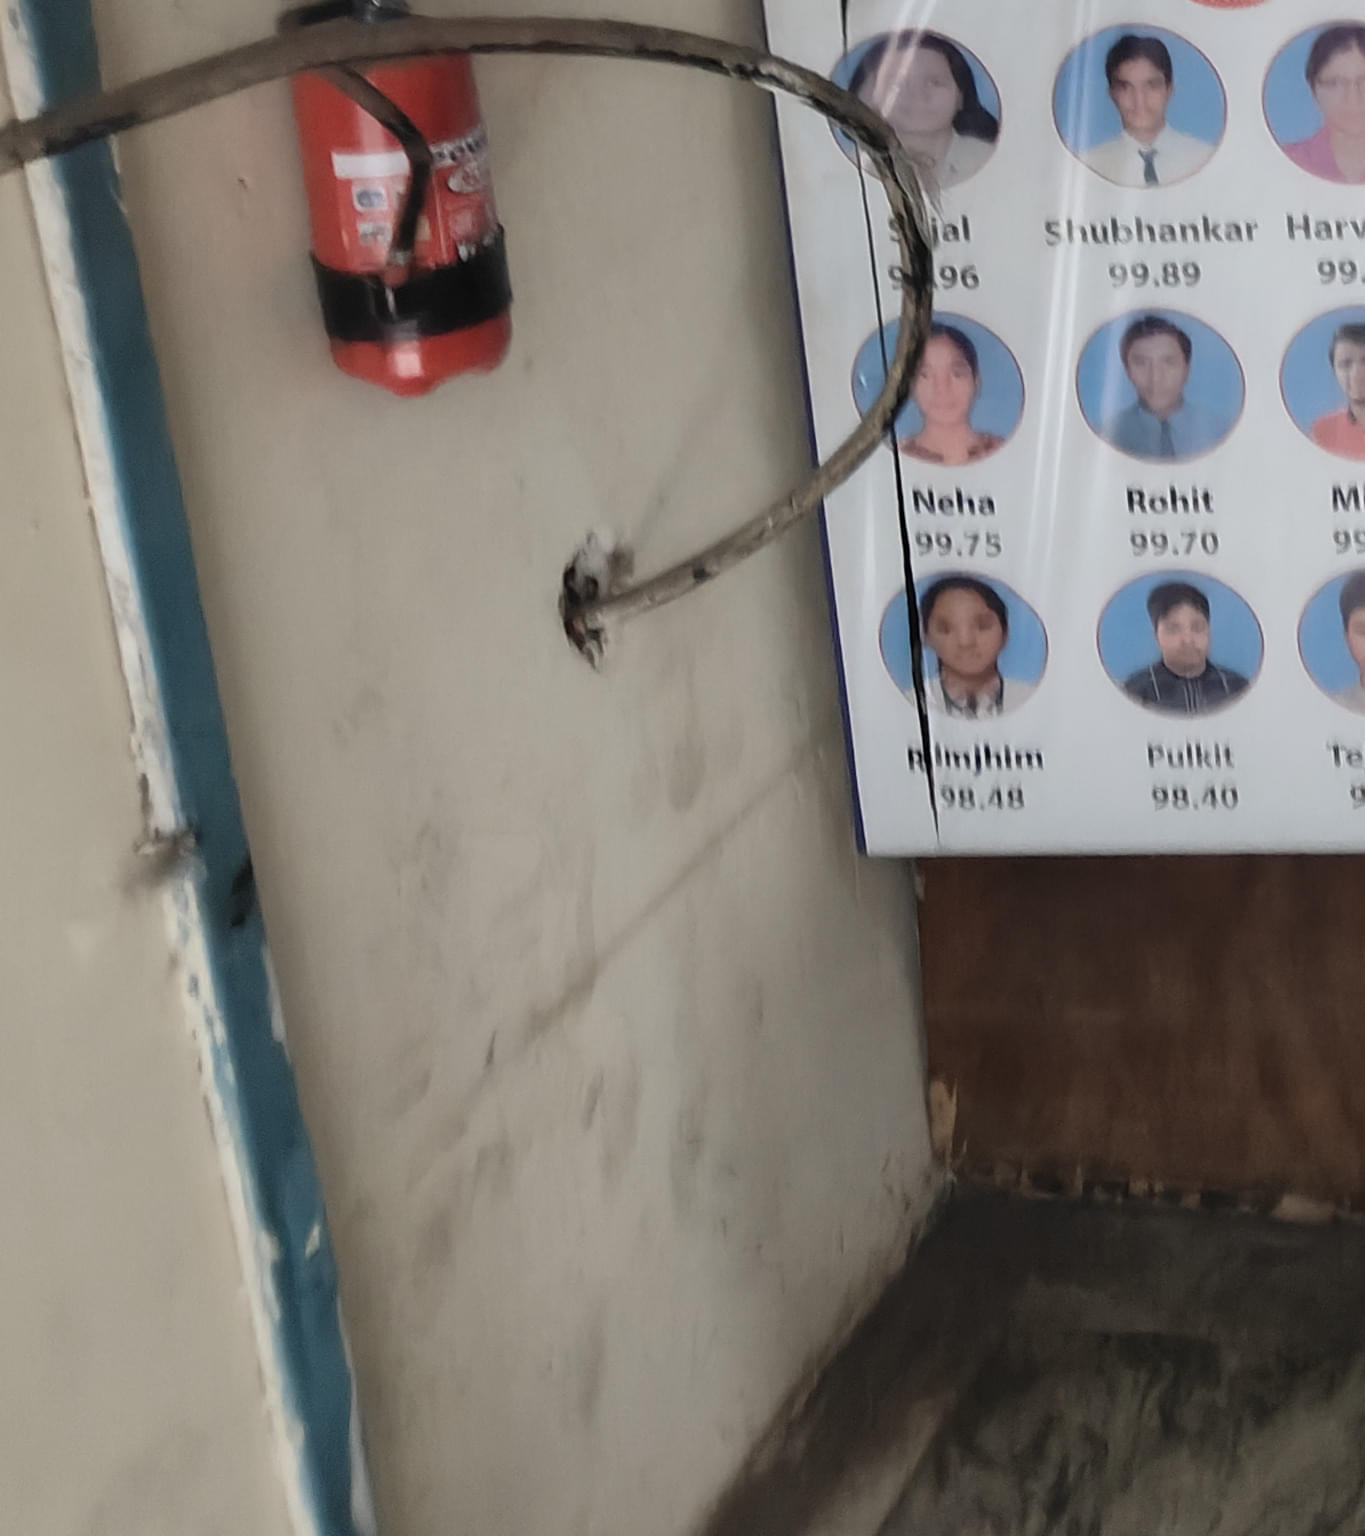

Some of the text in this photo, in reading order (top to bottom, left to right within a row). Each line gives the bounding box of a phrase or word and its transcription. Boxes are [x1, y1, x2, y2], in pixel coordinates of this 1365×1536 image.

[888, 214, 971, 249] Sjal
[1044, 214, 1258, 246] Shubhankar
[888, 265, 980, 290] 9.96
[1109, 262, 1200, 286] 99.89
[913, 489, 994, 514] Neha
[1127, 487, 1210, 512] Rohit
[916, 533, 1001, 556] 99.75
[1131, 532, 1218, 554] 99.70
[1148, 744, 1231, 767] Pulkit
[942, 788, 1023, 808] 98.48
[1153, 787, 1237, 807] 98.40
